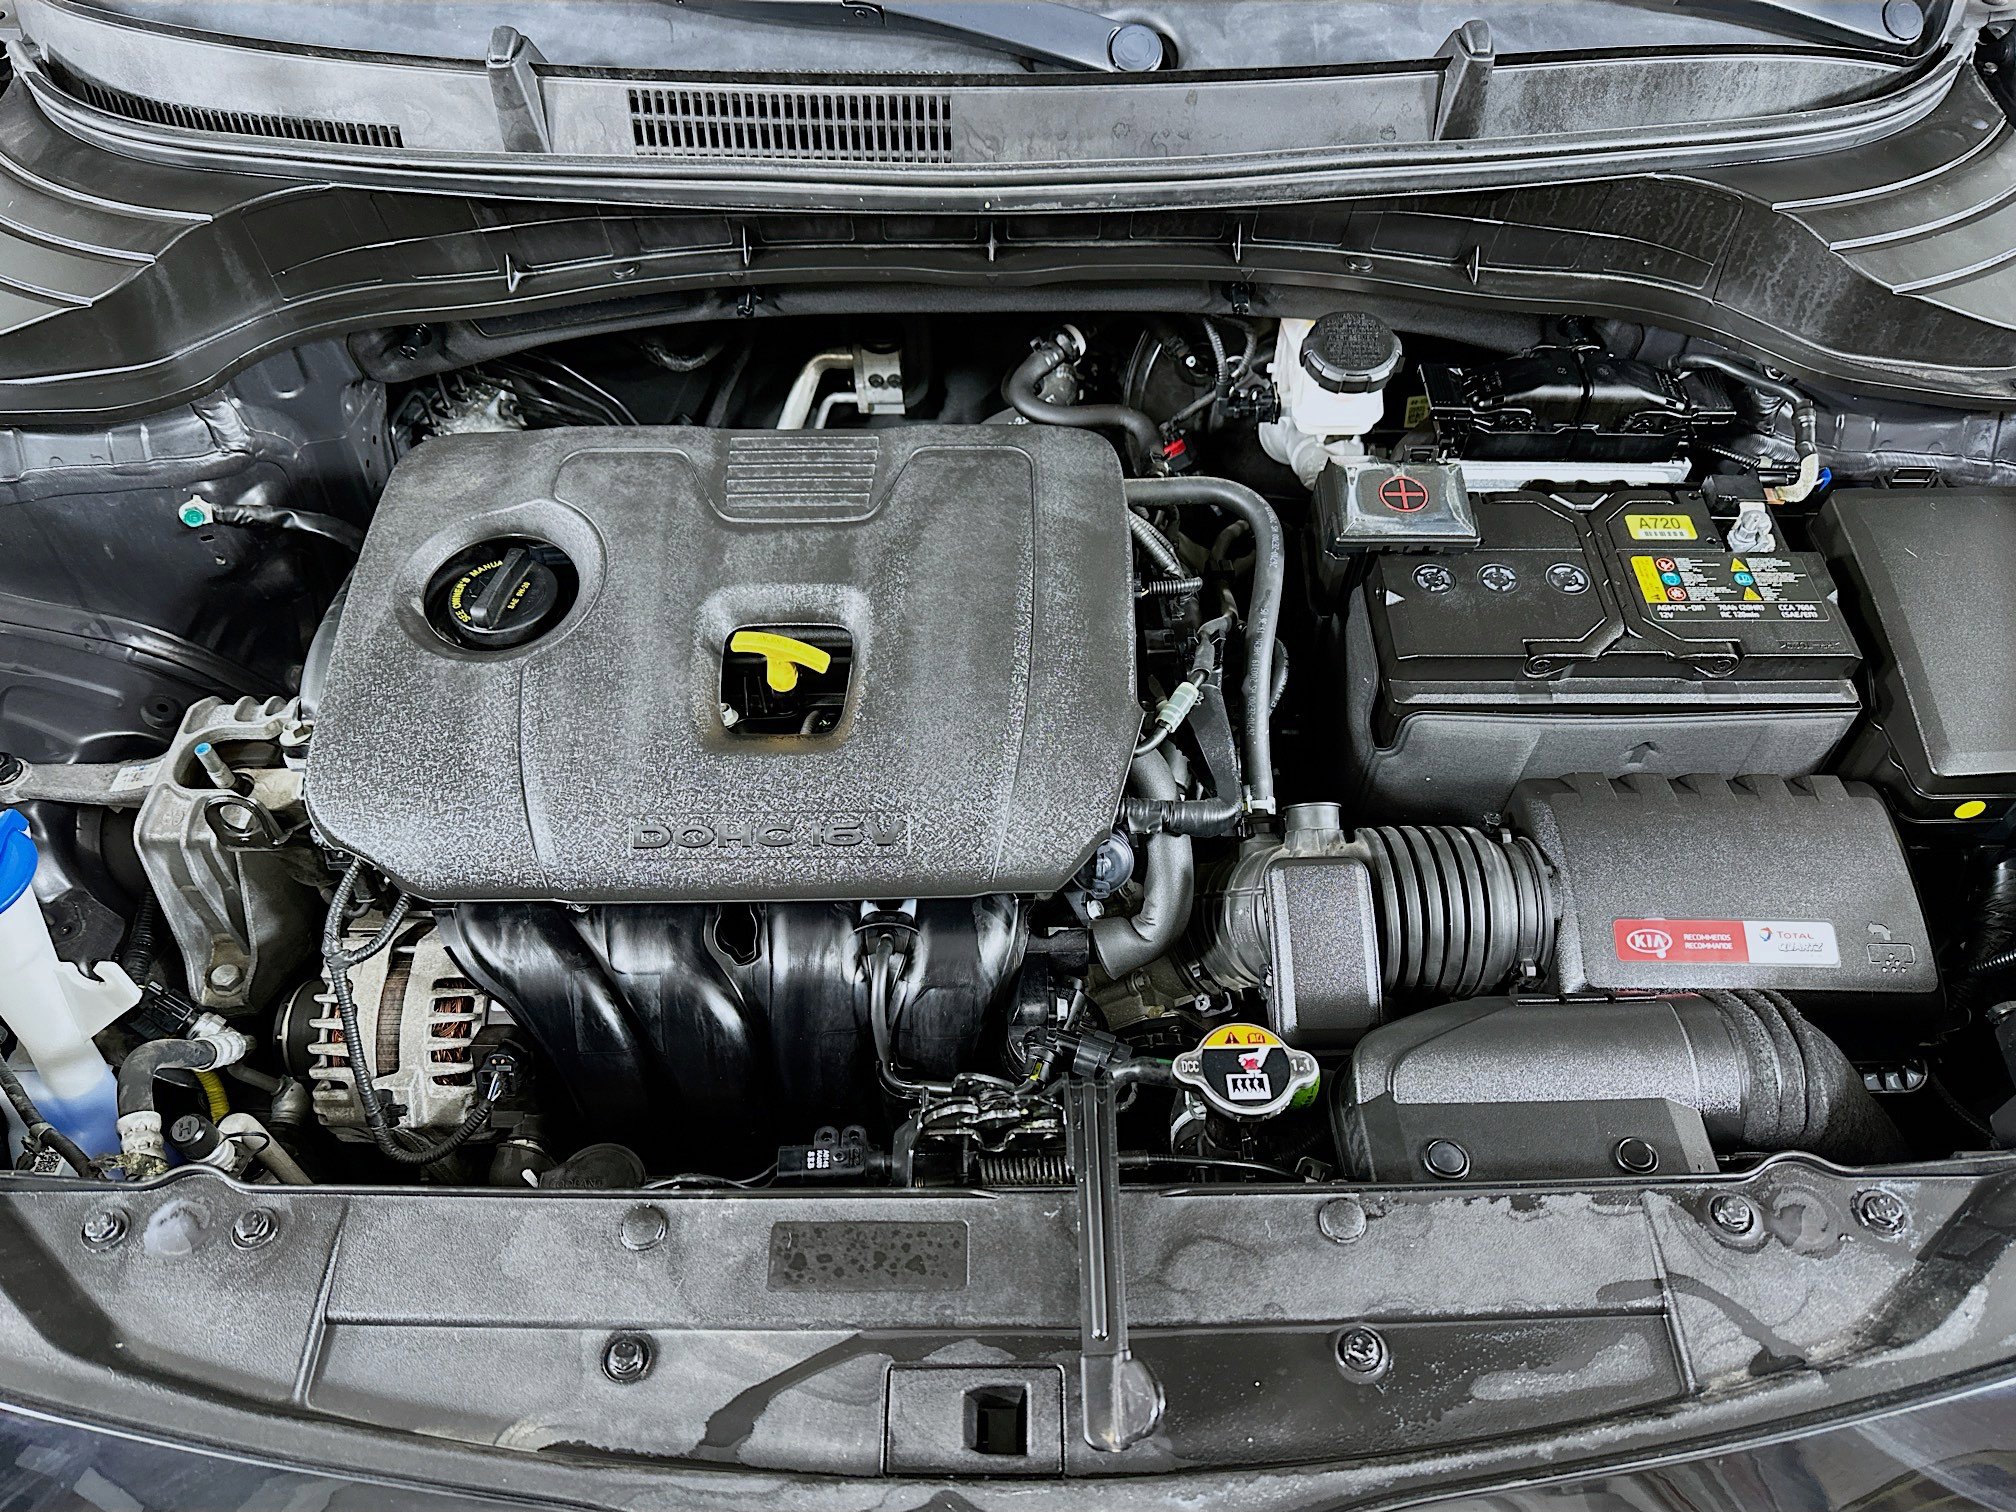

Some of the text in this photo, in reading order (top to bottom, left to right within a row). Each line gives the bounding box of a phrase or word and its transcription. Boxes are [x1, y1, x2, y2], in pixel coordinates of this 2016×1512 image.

[1639, 517, 1681, 530] A720
[454, 608, 471, 623] SEE
[469, 560, 504, 578] MANUA
[1659, 611, 1674, 619] 12V
[632, 821, 908, 850] DOHC 16V
[1683, 933, 1732, 942] RECOMMENDS
[1776, 930, 1814, 941] TOTAL
[1684, 941, 1734, 951] RECOMMANDE
[1777, 942, 1824, 953] QUARTZ
[1181, 1058, 1311, 1073] DCC 1.1
